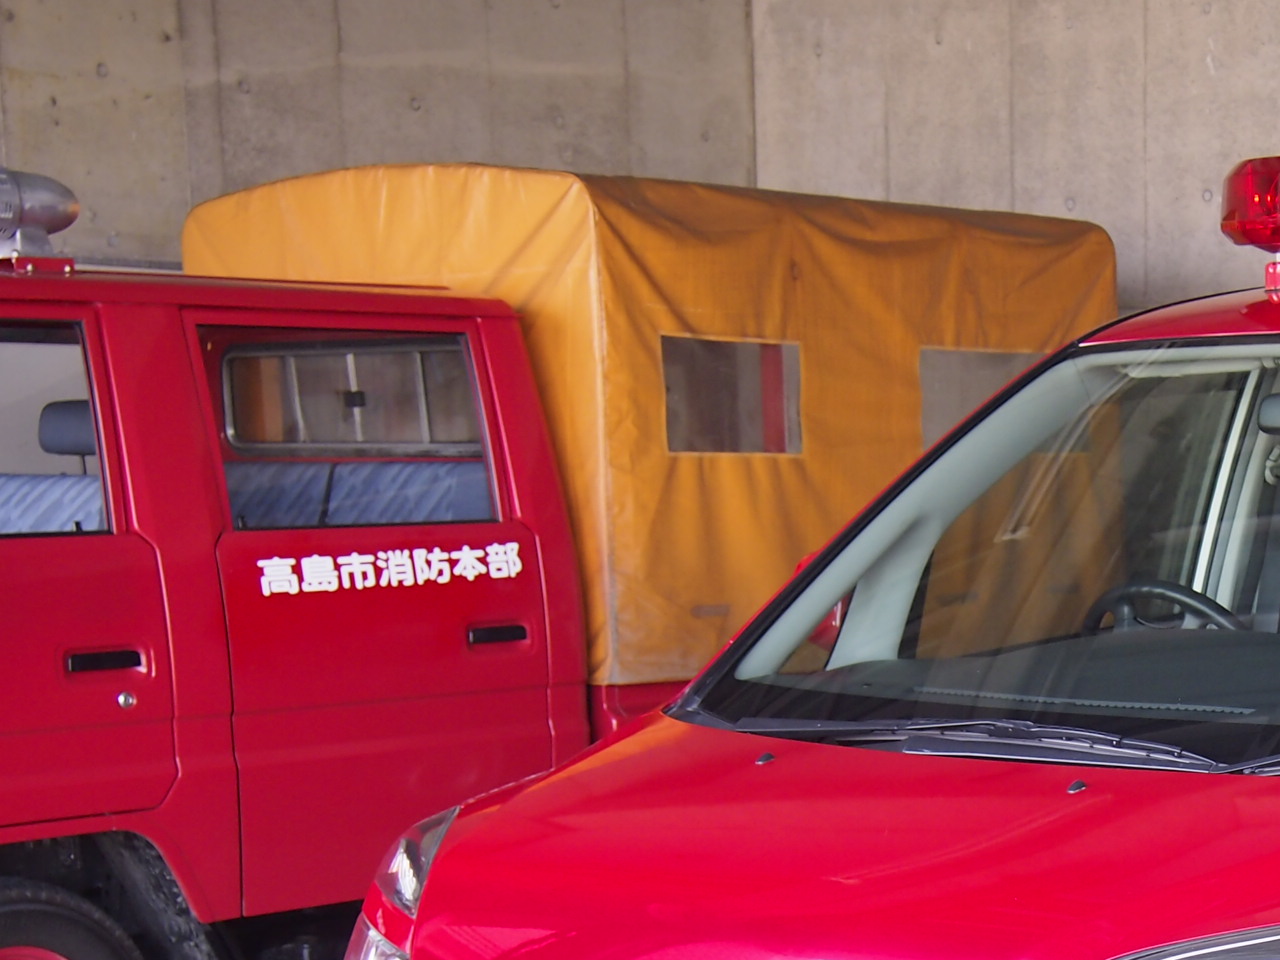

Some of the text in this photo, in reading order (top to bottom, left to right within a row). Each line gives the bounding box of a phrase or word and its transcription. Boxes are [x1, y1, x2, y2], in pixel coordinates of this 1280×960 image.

[257, 541, 523, 596] 高島市消防本部
